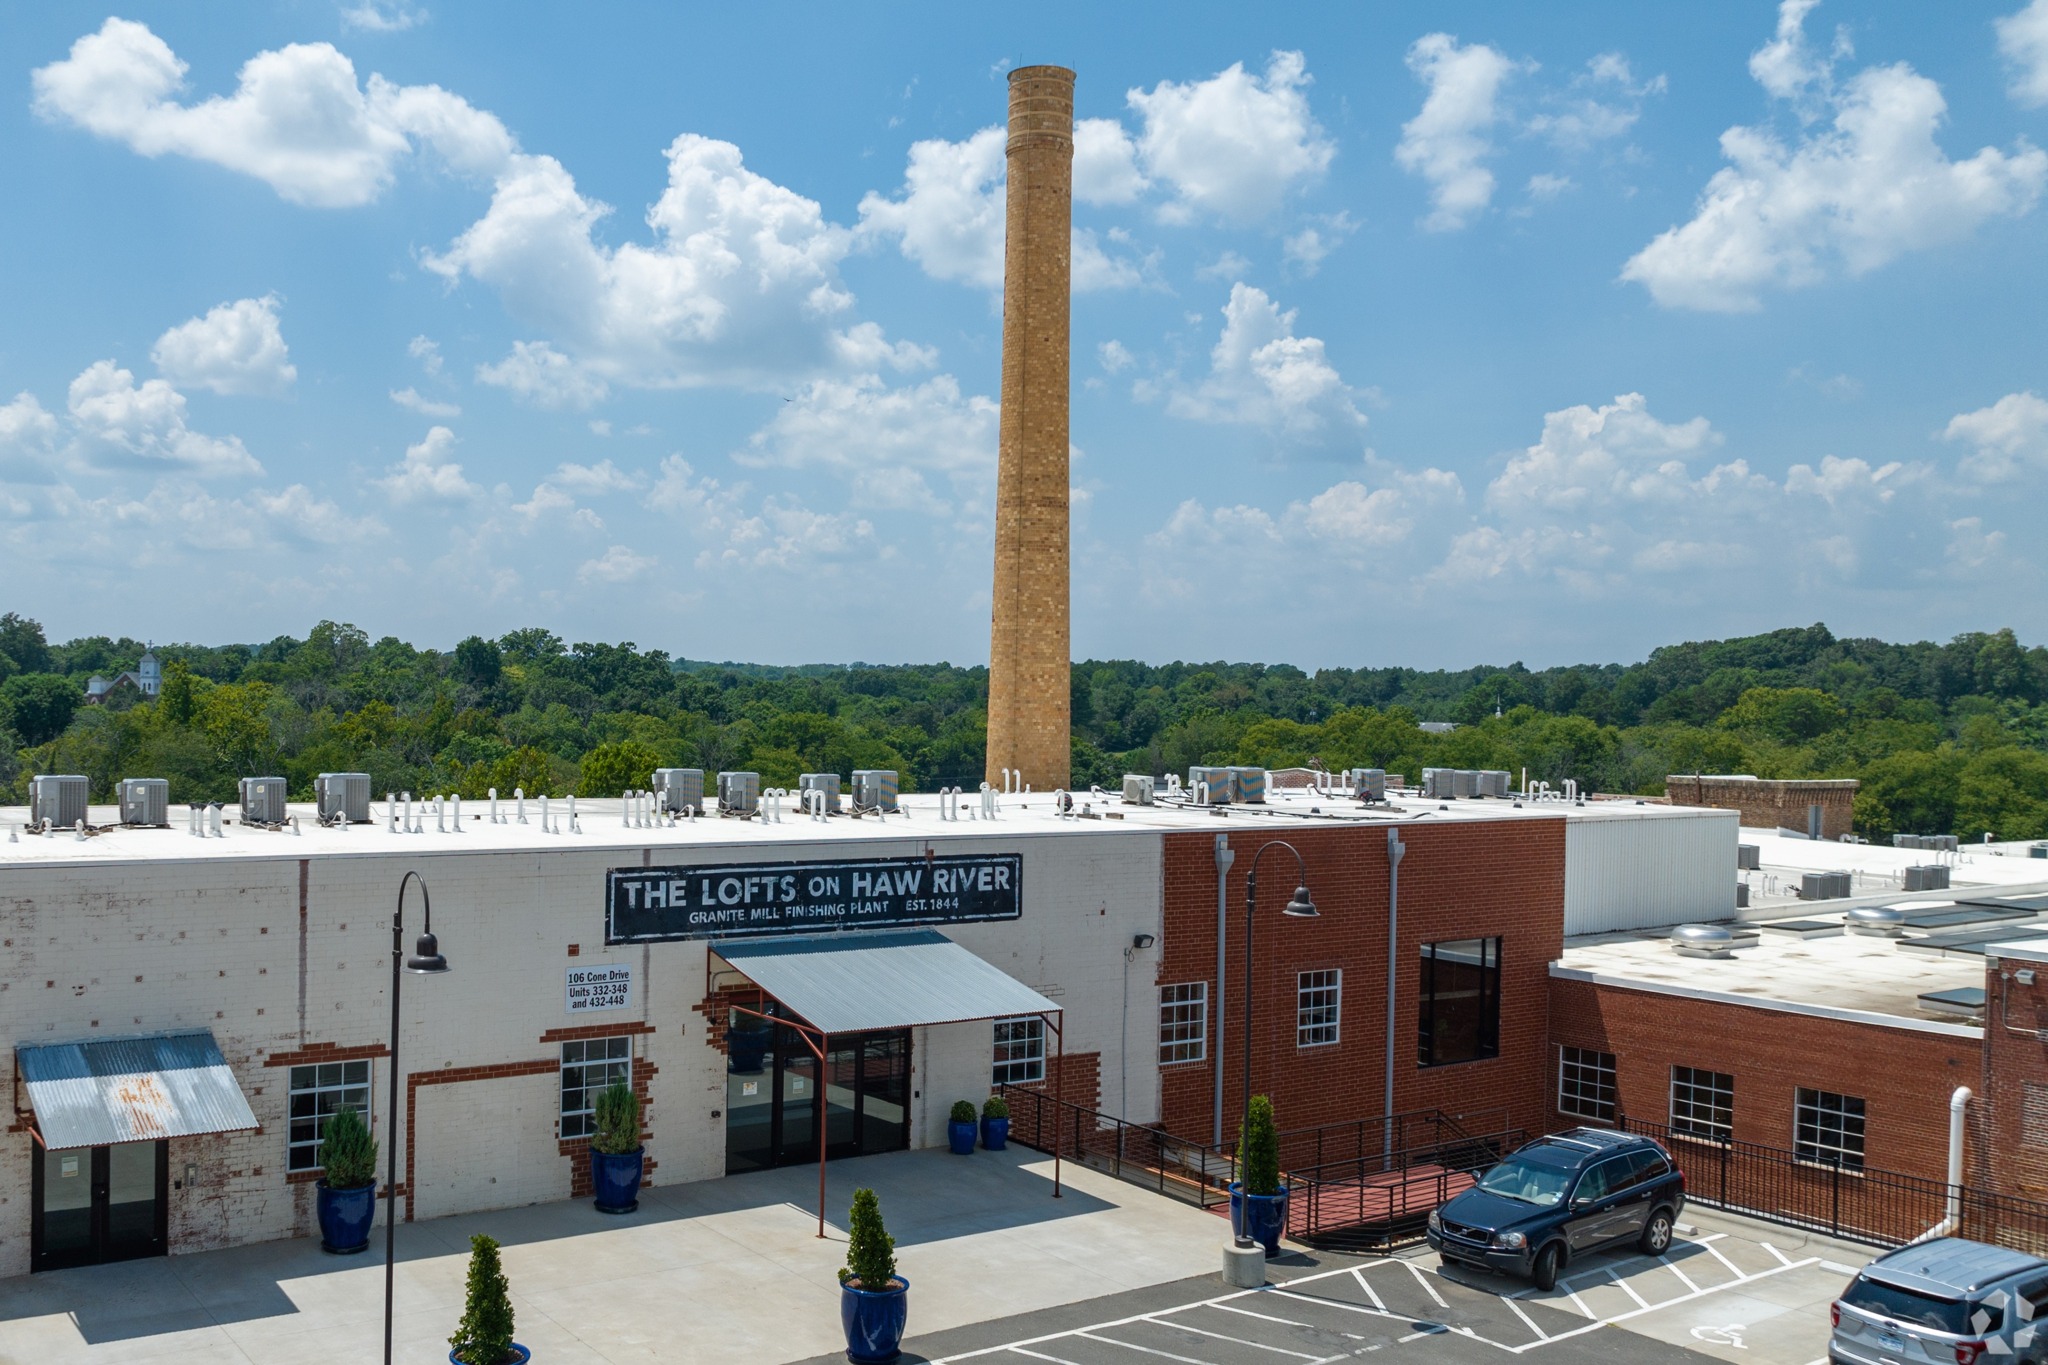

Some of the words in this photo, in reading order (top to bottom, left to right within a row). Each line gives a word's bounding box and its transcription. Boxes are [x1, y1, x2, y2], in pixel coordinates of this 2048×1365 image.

[622, 880, 687, 909] THE
[702, 875, 796, 906] LOFTS
[808, 876, 840, 897] ON
[852, 869, 922, 898] HAW
[932, 866, 1010, 893] RIVER
[689, 909, 745, 924] GRANITE
[751, 907, 780, 920] MILL
[785, 903, 846, 918] FINISHING
[851, 900, 889, 914] PLANT
[906, 899, 927, 911] EST.
[930, 897, 959, 910] 1844
[568, 972, 585, 984] 106
[587, 972, 607, 982] Cone
[609, 970, 630, 980] Drive
[569, 987, 590, 998] Units
[592, 983, 628, 996] 332-348
[572, 998, 587, 1009] and
[589, 995, 625, 1007] 432-448
